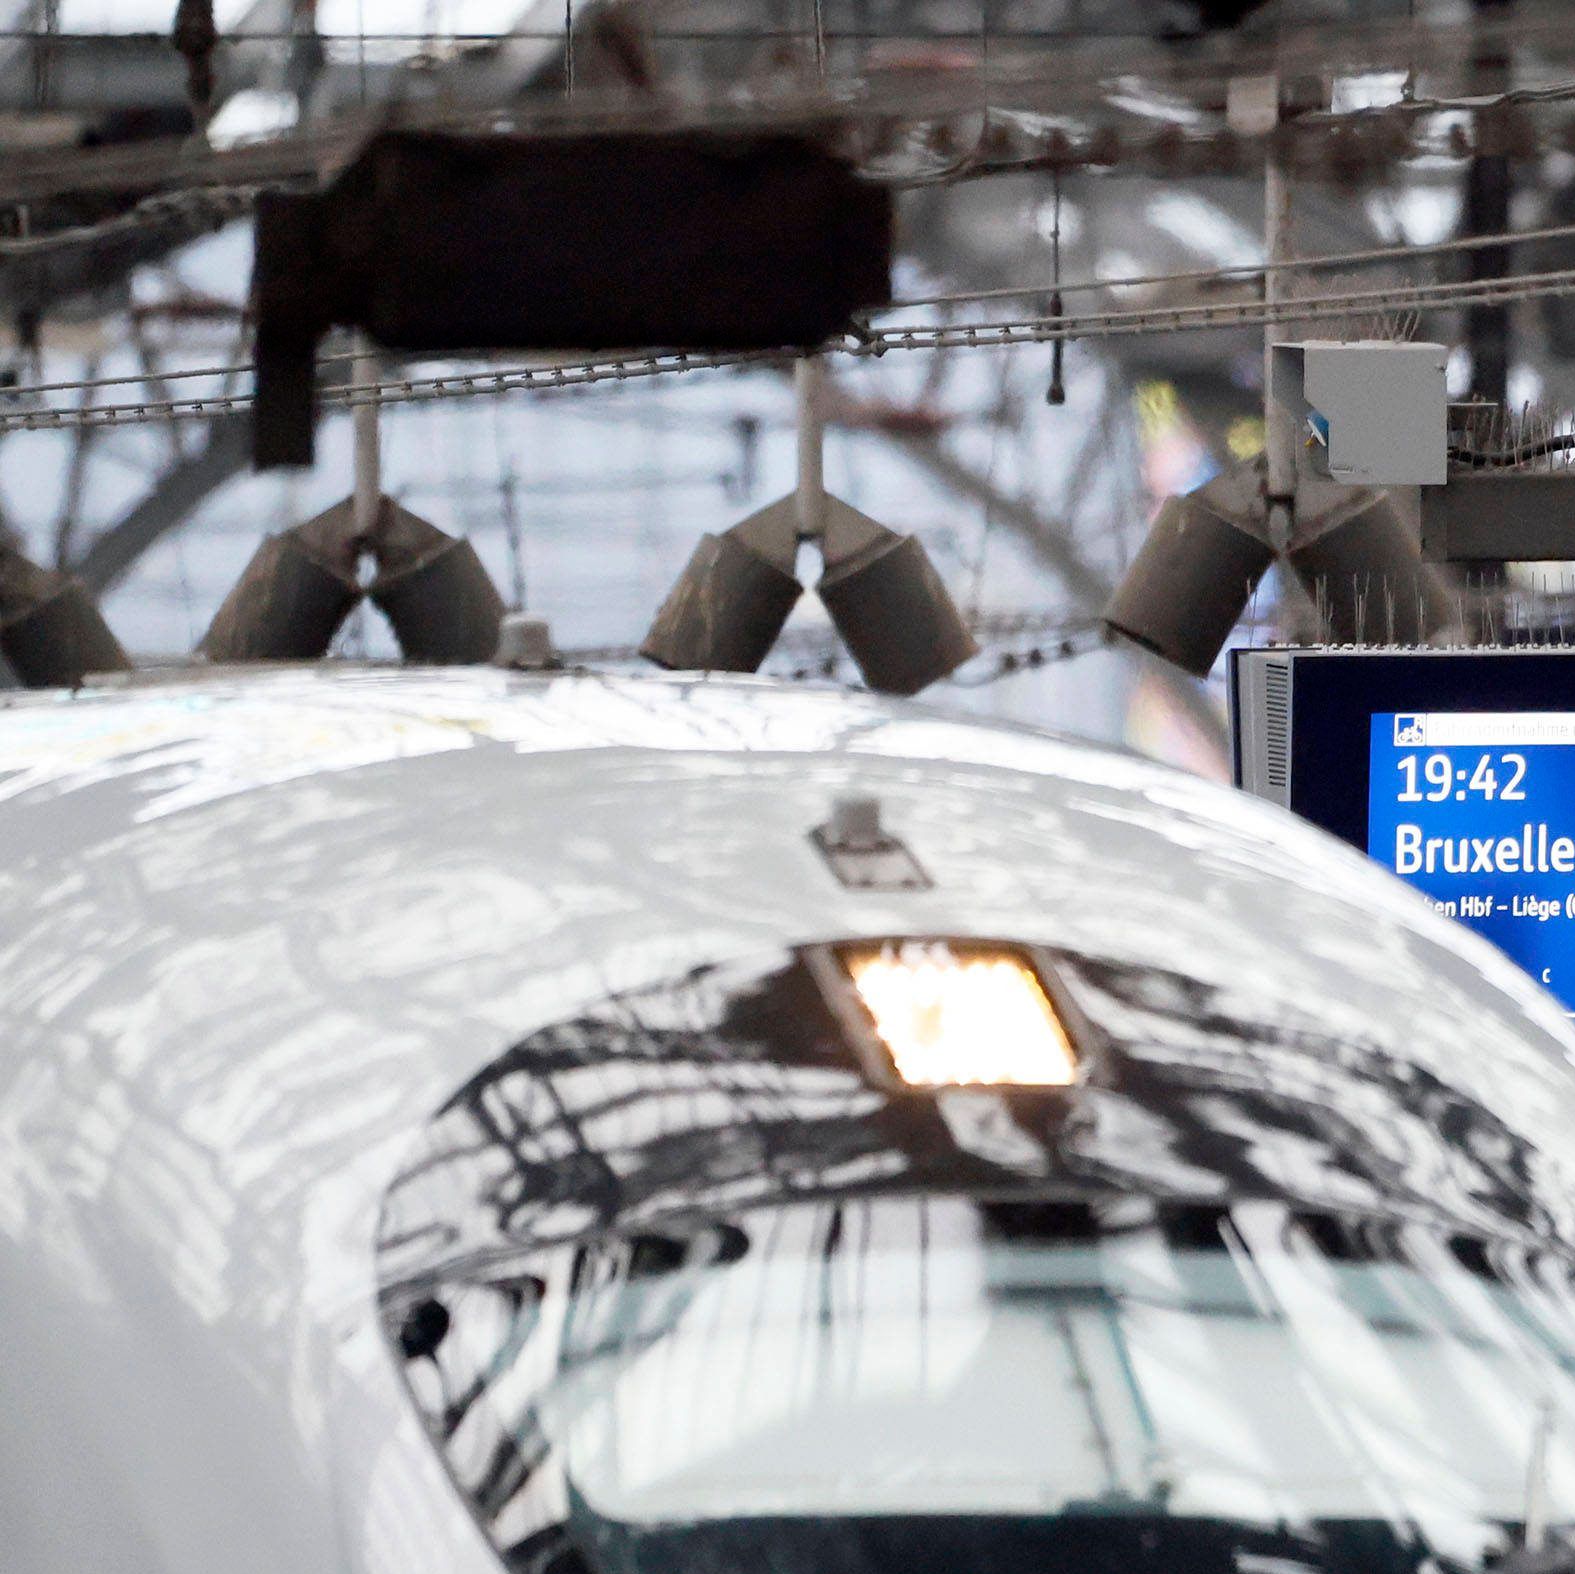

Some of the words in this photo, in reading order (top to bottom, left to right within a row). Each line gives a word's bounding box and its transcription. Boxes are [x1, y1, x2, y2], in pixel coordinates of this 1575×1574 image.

[1398, 754, 1526, 801] 19:42
[1461, 896, 1493, 916] Hbf
[1513, 895, 1560, 920] Liège
